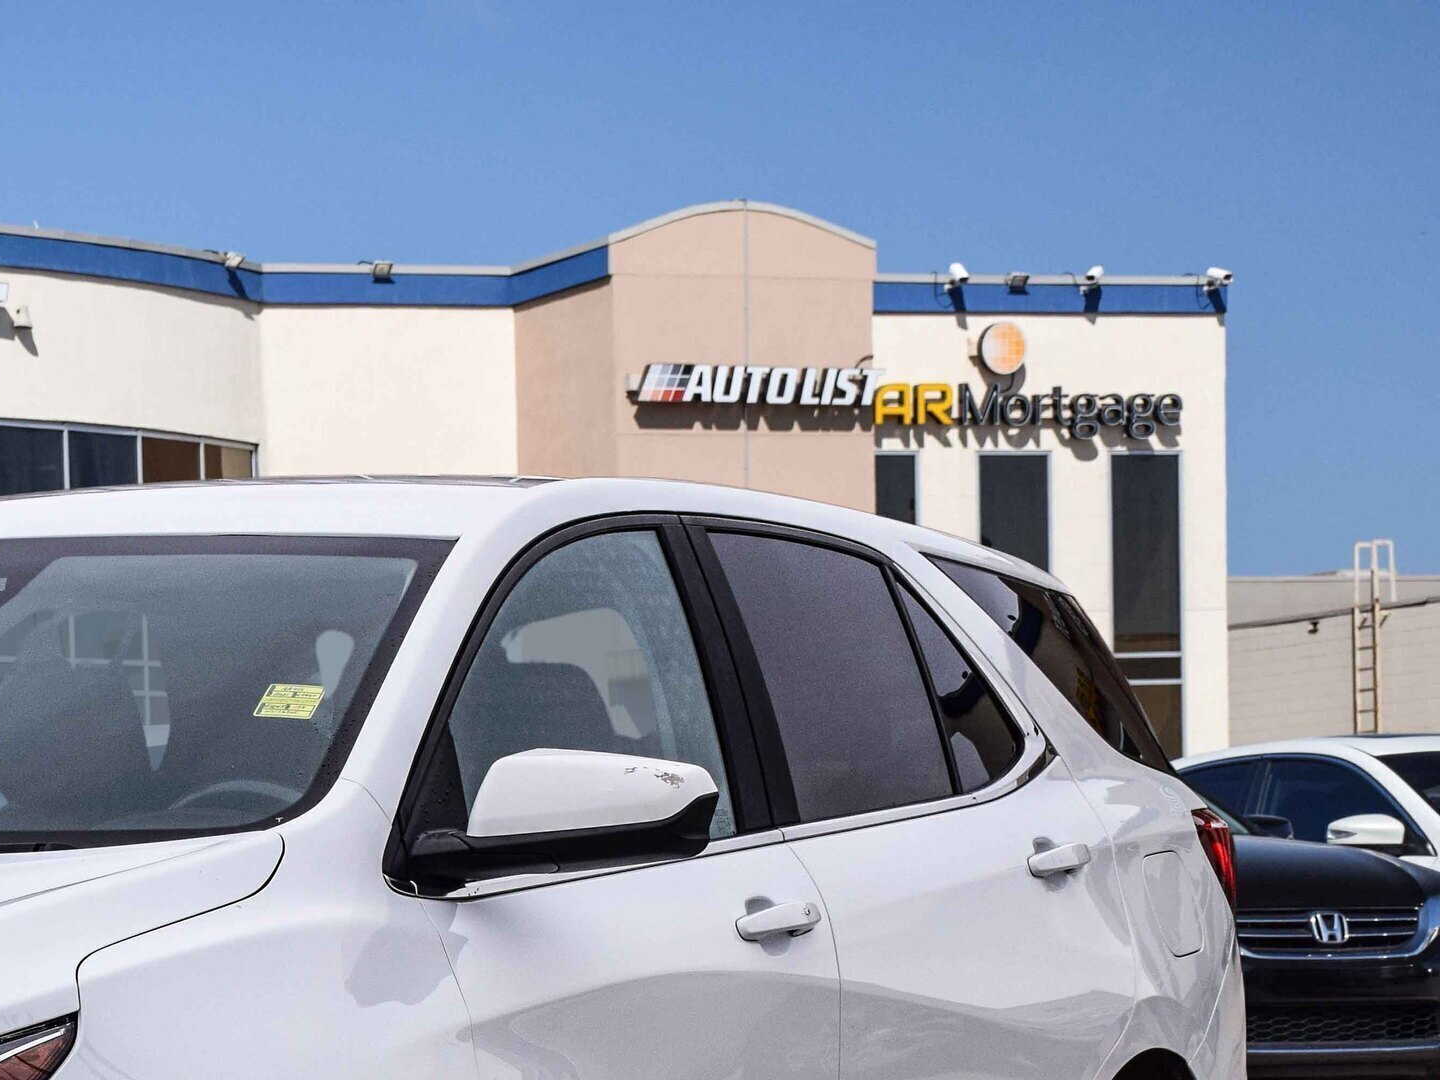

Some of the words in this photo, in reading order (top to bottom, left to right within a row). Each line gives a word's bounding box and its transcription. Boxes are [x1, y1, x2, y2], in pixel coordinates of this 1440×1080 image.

[683, 364, 796, 405] AUTO
[798, 367, 887, 406] LIST
[874, 382, 953, 426] AR
[961, 381, 1185, 440] Mortgage
